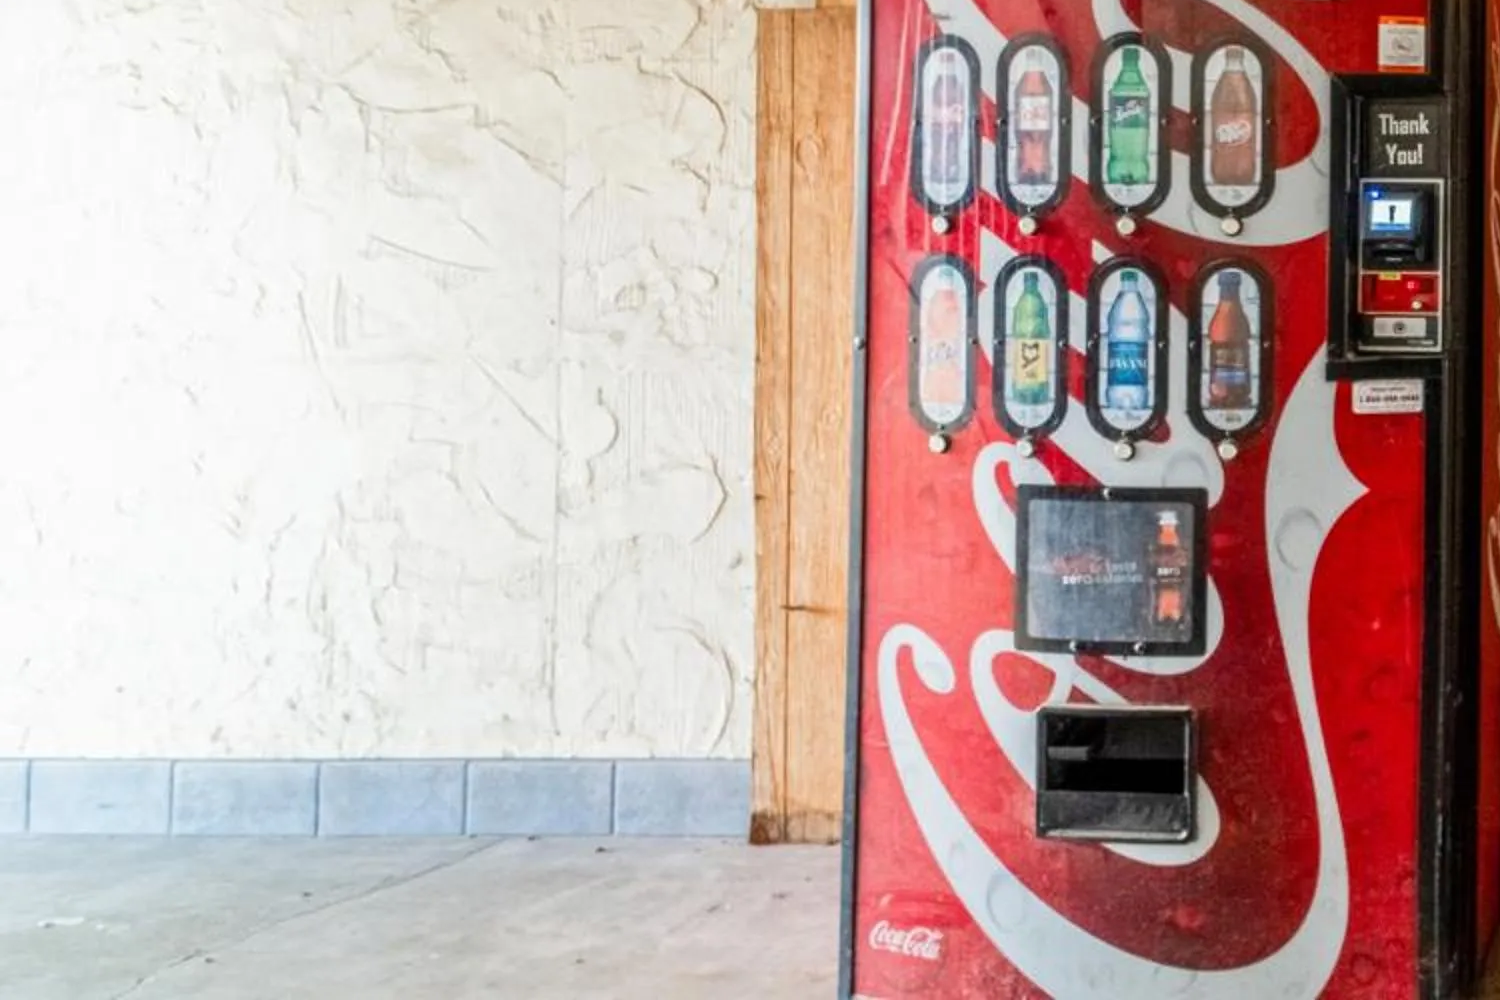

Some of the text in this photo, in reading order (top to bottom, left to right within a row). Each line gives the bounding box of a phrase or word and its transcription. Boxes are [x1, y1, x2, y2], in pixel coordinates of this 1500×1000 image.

[1378, 112, 1430, 135] Thank
[1385, 143, 1423, 165] You!
[868, 919, 945, 961] Coca-Cola
